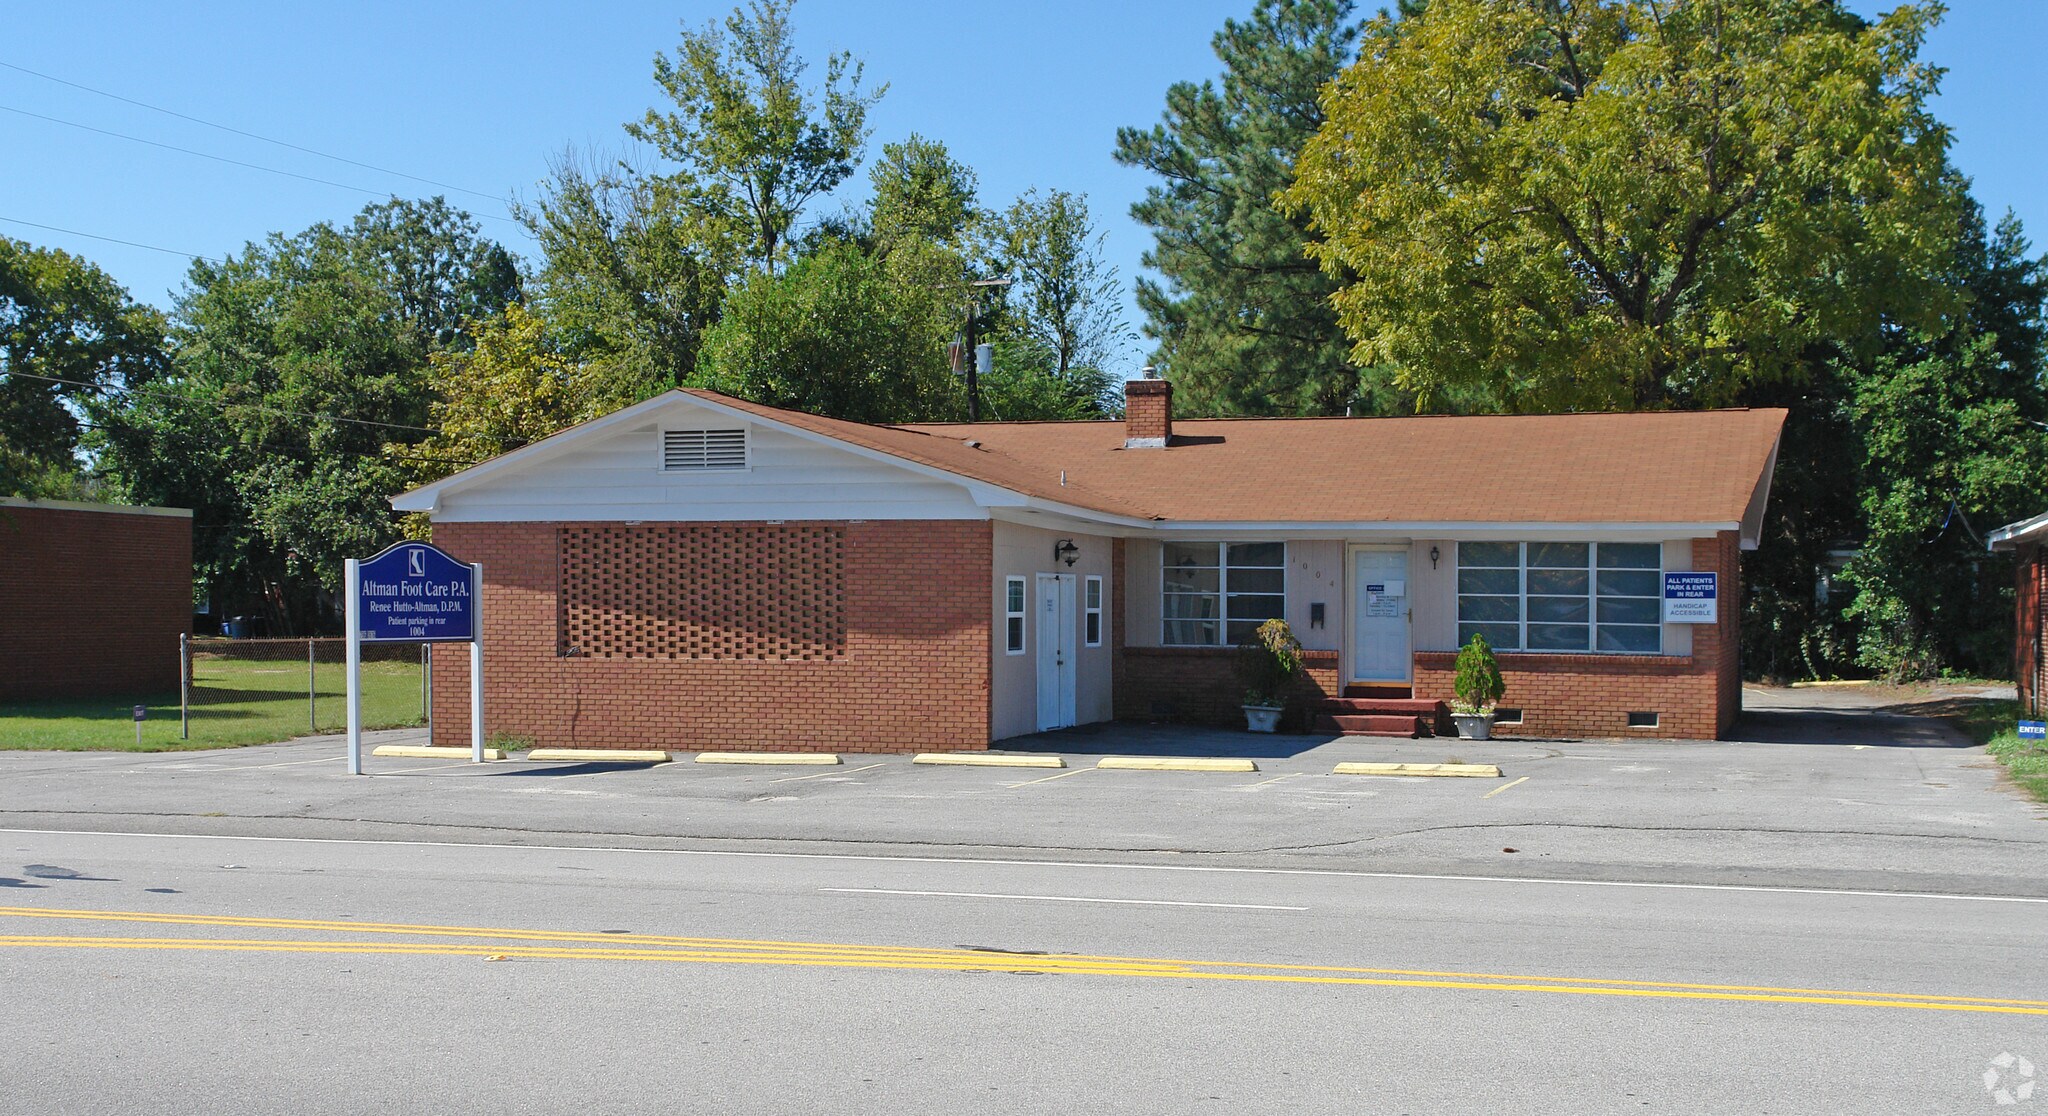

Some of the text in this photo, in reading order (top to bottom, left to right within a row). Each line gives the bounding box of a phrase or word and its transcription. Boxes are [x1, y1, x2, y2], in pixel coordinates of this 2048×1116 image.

[362, 580, 469, 597] Altman Foot Care P.A.
[370, 601, 463, 613] Renee Hutto-Altman, D.P.M.
[388, 616, 446, 627] Patient parking in rear
[409, 627, 425, 636] 1004
[2019, 725, 2046, 734] ENTER
